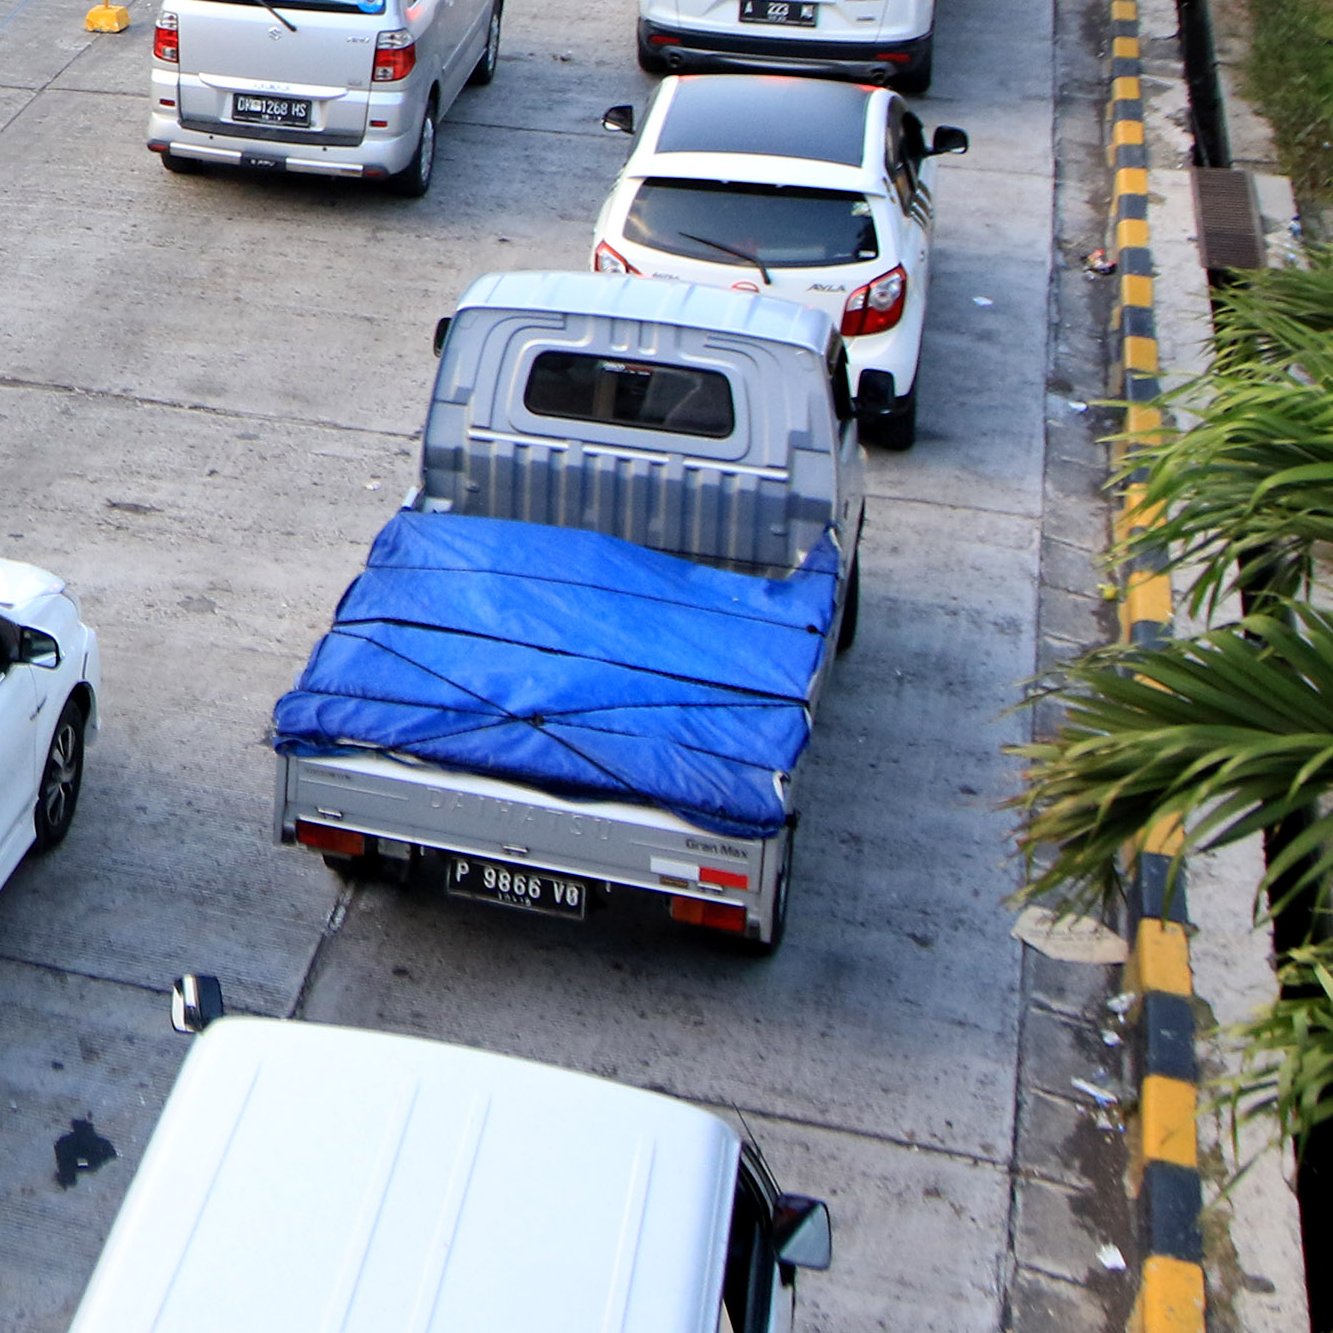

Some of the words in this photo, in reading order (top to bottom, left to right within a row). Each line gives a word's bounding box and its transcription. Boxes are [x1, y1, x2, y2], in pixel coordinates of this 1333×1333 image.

[261, 100, 288, 116] 1268
[291, 103, 307, 117] HS
[428, 786, 612, 840] DAIHATSU
[685, 838, 718, 855] Gran
[720, 843, 749, 860] Max
[455, 862, 470, 883] P
[482, 870, 542, 898] 9866
